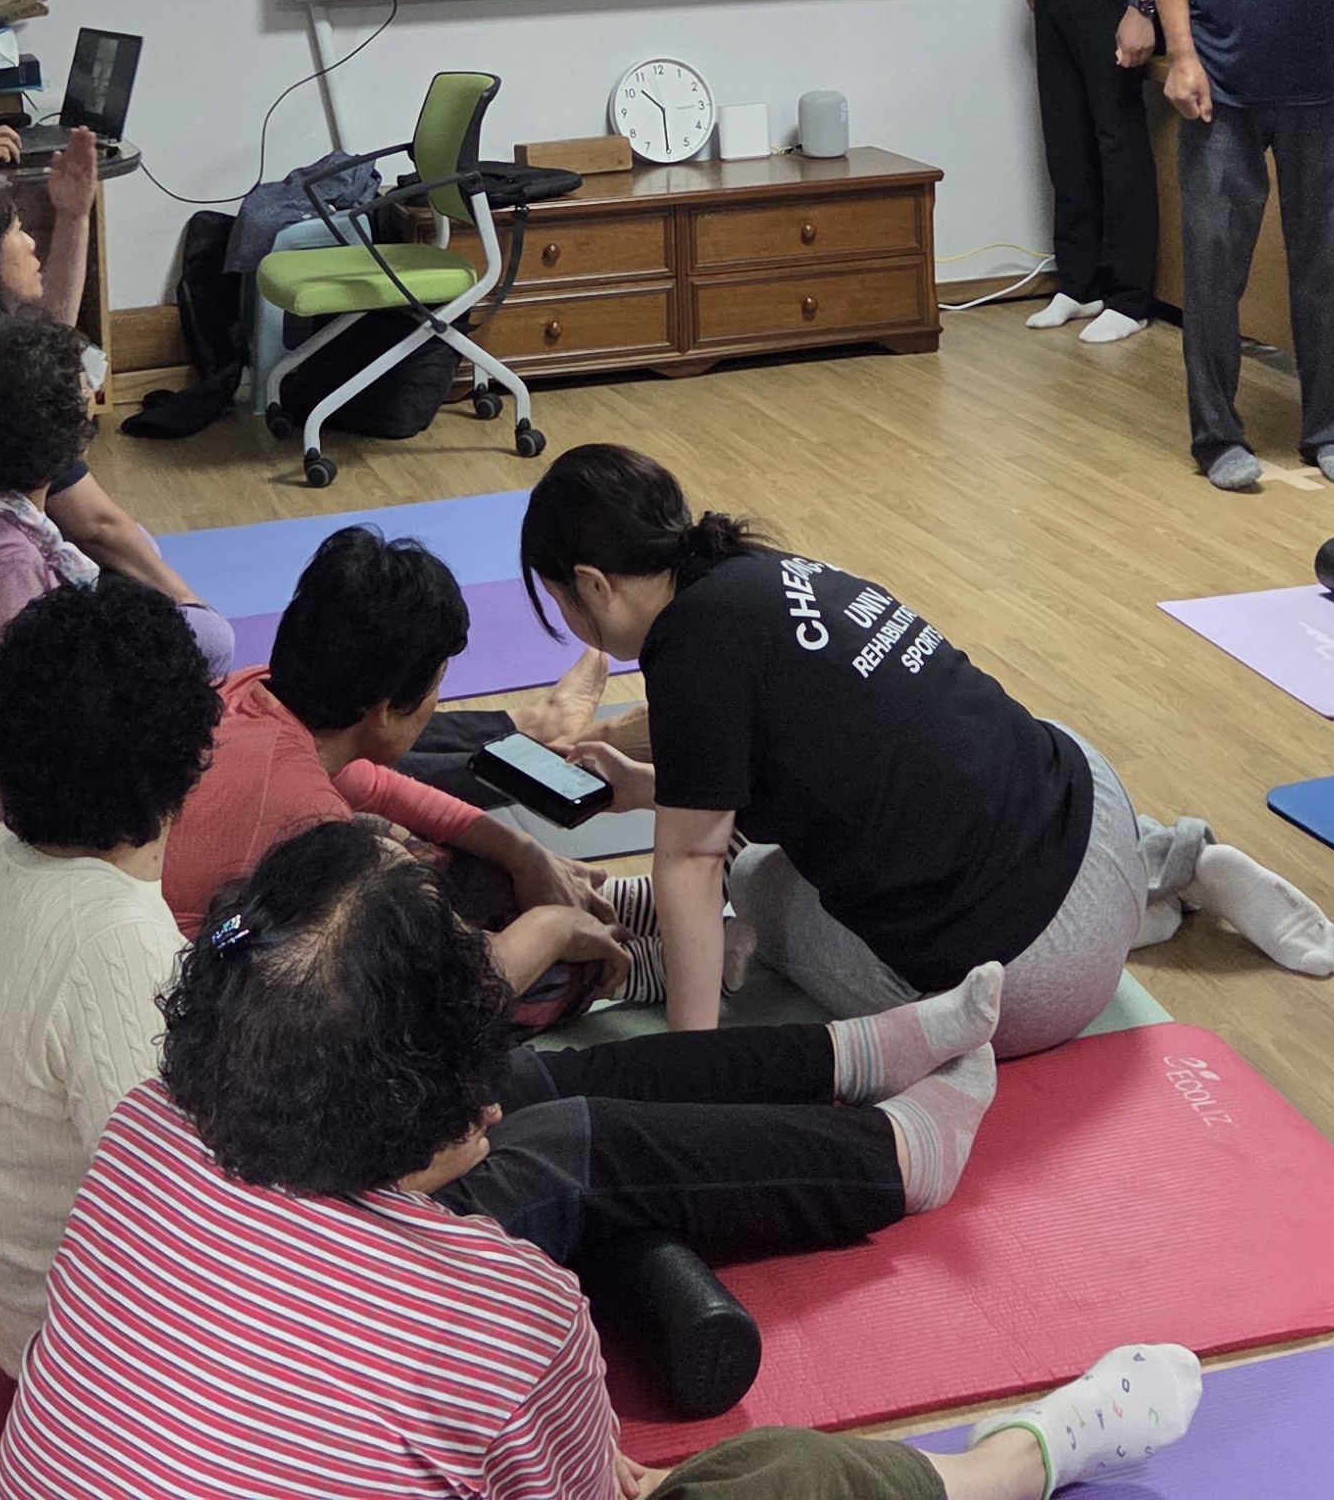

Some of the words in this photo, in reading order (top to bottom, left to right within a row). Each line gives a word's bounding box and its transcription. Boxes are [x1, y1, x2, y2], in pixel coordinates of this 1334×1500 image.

[653, 64, 664, 75] 12
[677, 68, 681, 78] 1
[635, 72, 645, 82] 11
[691, 81, 698, 92] 2
[624, 88, 636, 99] 10
[698, 100, 705, 111] 3
[621, 108, 627, 118] 9
[695, 120, 702, 129] 4
[629, 128, 637, 138] 8
[644, 141, 651, 152] 7
[683, 137, 690, 147] 5
[843, 586, 894, 629] UNIV.
